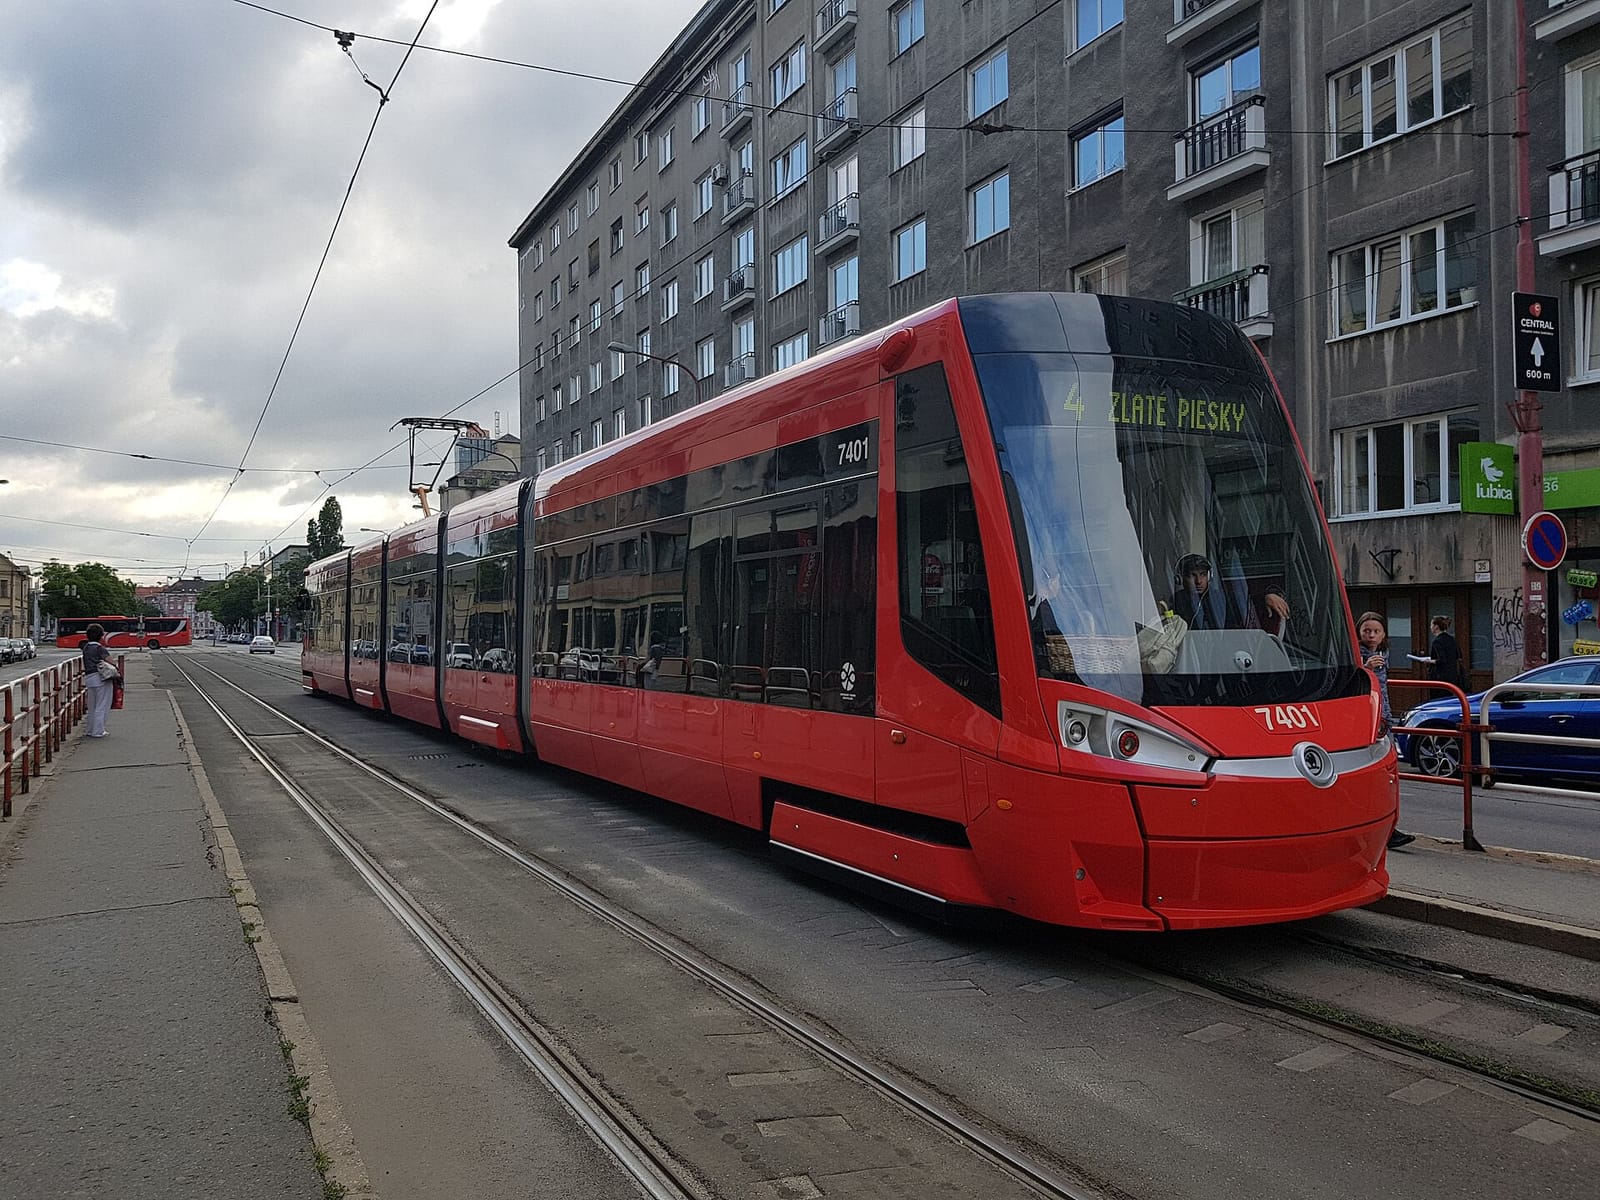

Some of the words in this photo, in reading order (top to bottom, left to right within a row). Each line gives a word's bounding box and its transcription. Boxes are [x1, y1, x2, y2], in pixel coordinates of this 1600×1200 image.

[1520, 318, 1555, 330] CENTRAL
[1526, 369, 1542, 379] 600
[1543, 372, 1551, 380] m
[1063, 382, 1085, 422] 4
[1107, 391, 1168, 426] ZLATÉ
[1178, 398, 1245, 433] PIESKY
[837, 436, 868, 466] 7401
[1254, 704, 1319, 731] 7401
